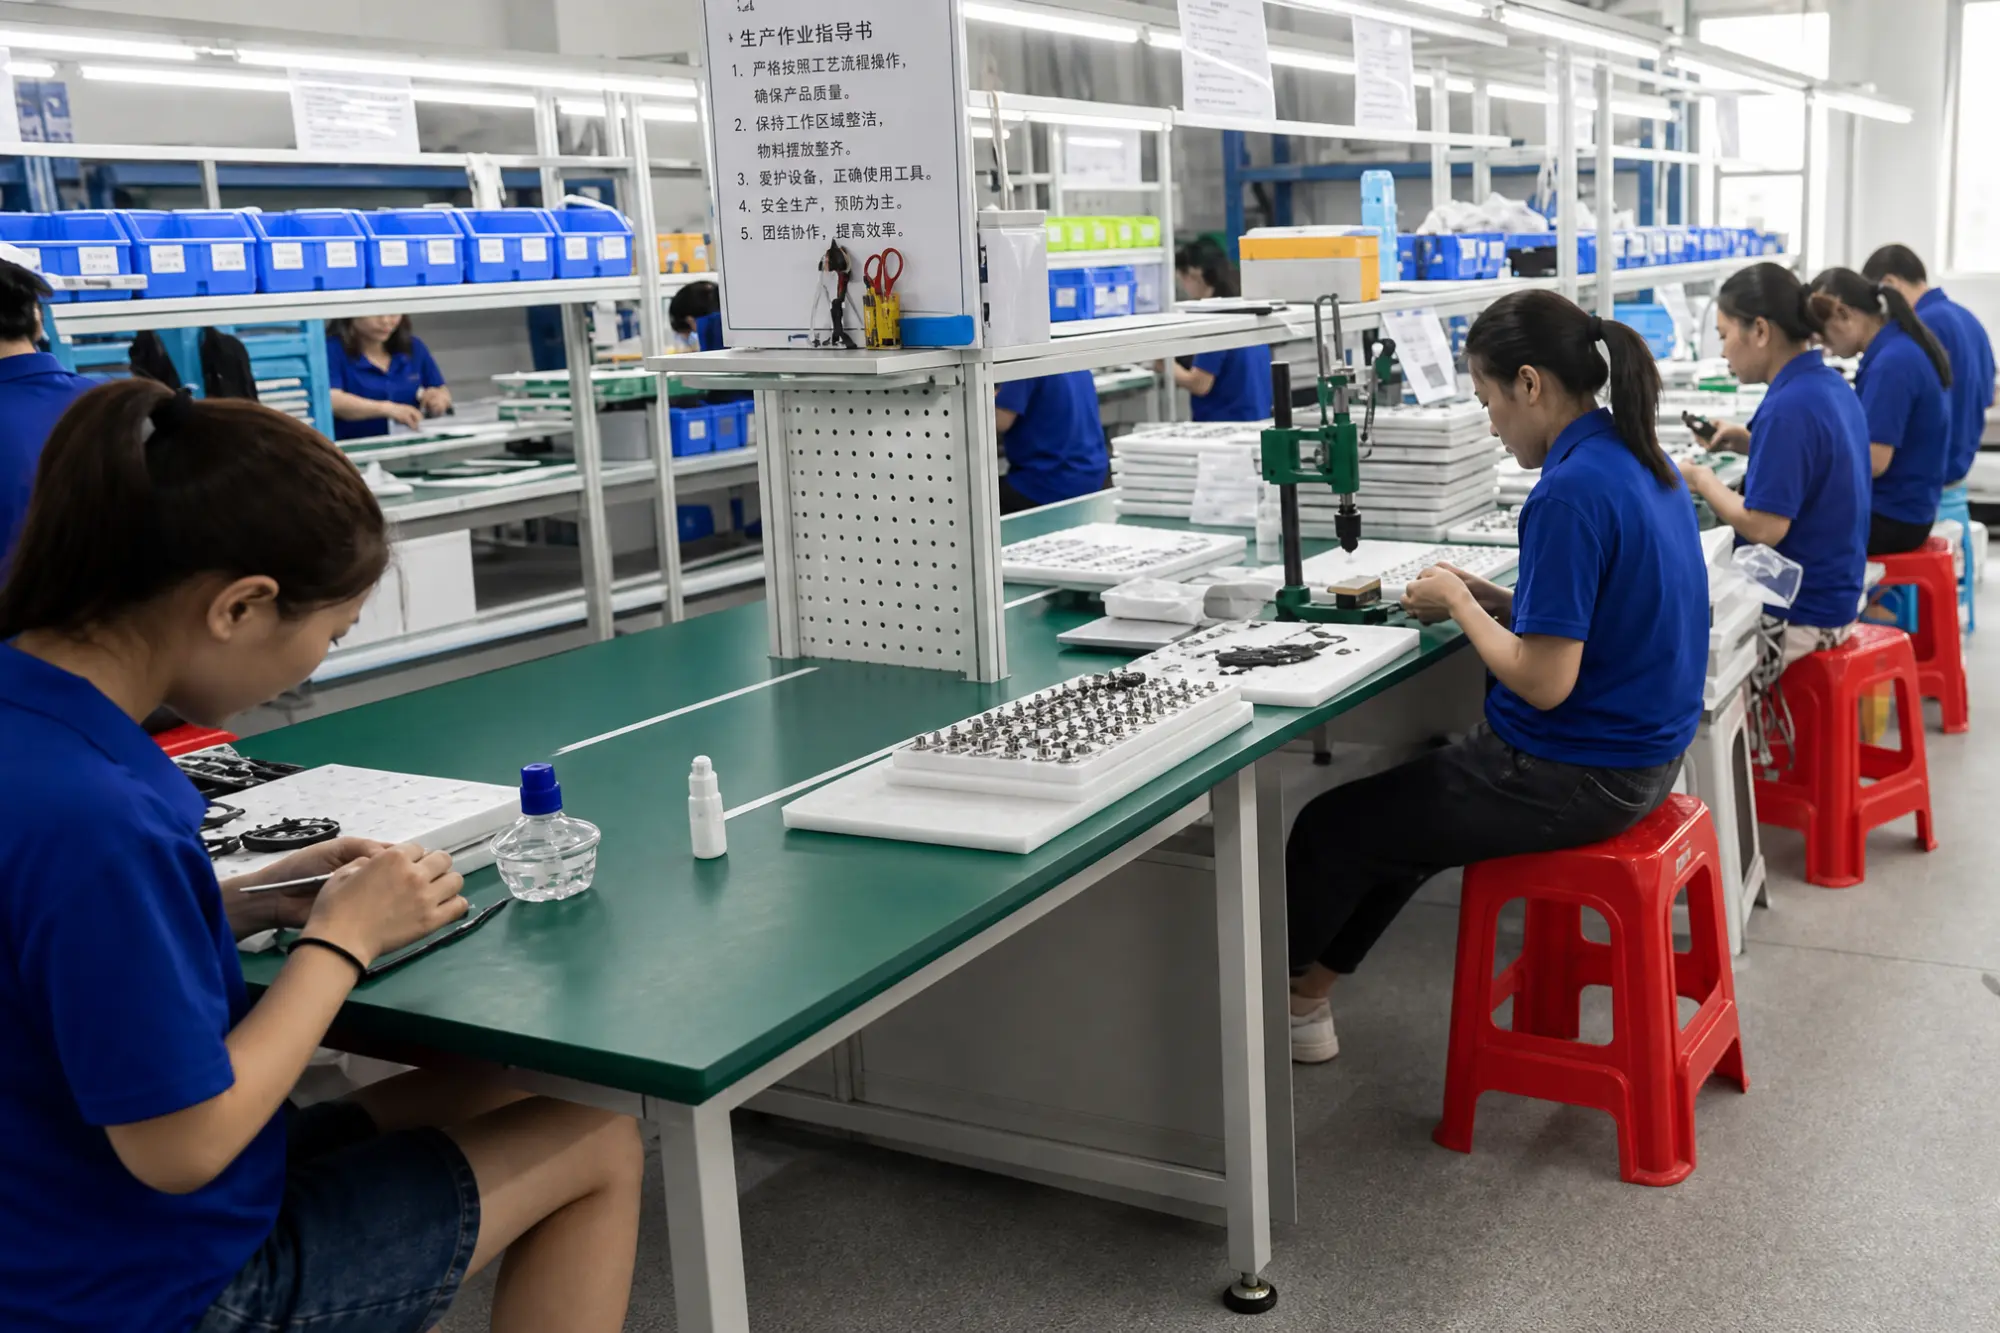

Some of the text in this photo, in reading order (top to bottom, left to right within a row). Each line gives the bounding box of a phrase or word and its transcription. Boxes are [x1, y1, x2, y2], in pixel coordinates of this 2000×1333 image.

[739, 19, 873, 48] 生产作业指导书
[731, 63, 744, 78] 1.
[734, 117, 747, 132] 2.
[737, 171, 749, 187] 3.
[738, 199, 751, 213] 4.
[740, 226, 753, 241] 5.
